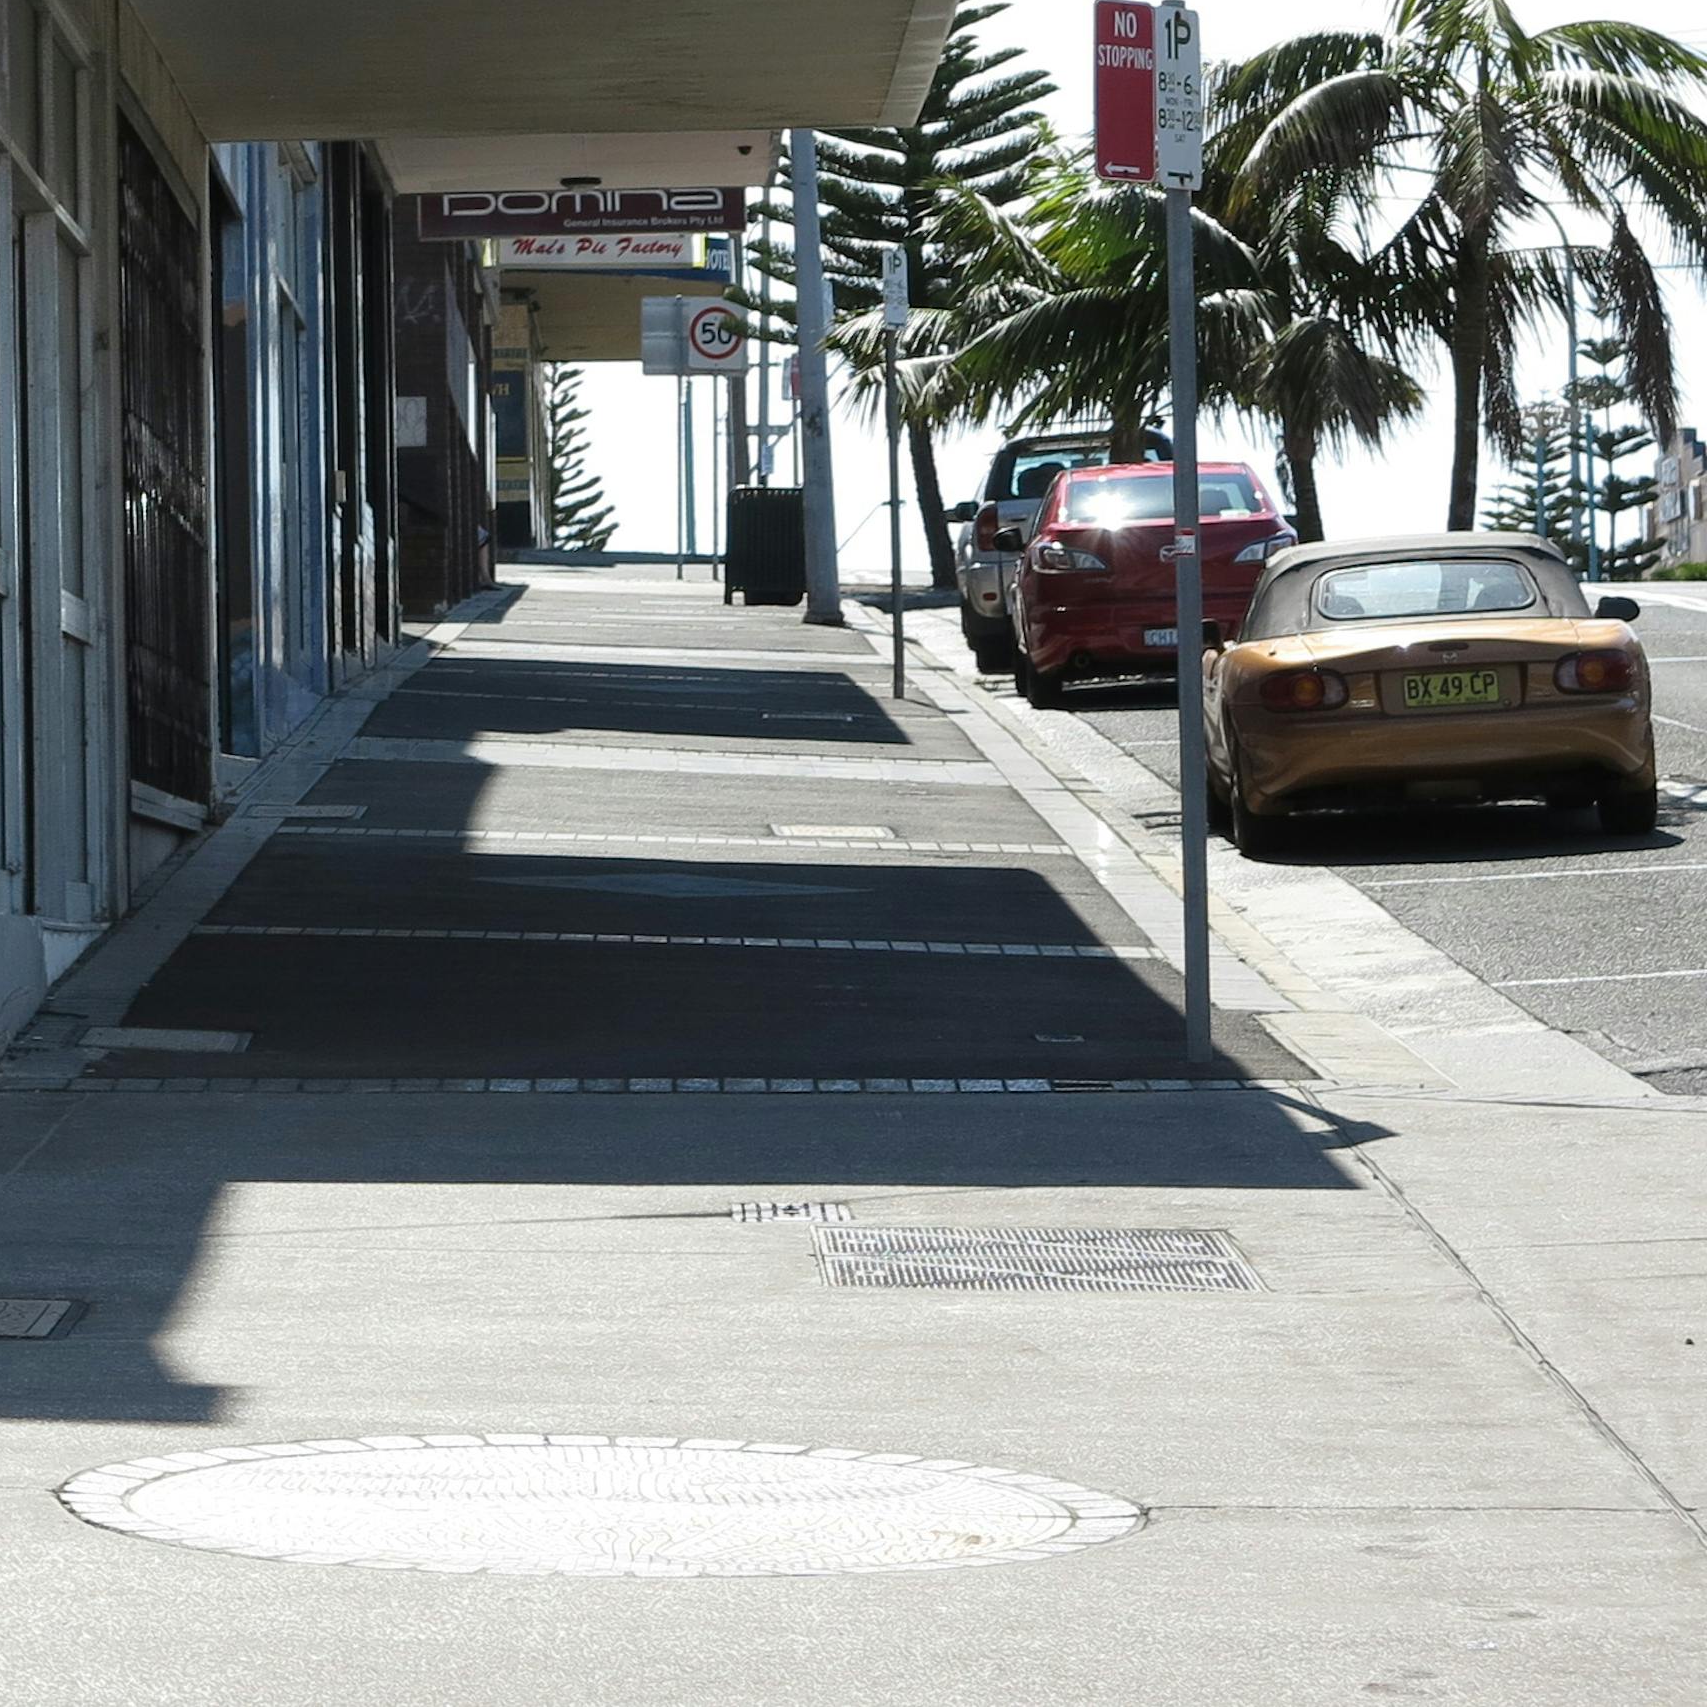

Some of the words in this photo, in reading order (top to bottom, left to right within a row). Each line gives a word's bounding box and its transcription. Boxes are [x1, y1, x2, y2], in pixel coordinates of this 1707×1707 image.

[1114, 10, 1137, 39] NO
[1165, 13, 1191, 60] 1P
[1098, 45, 1153, 71] STOPPING
[563, 217, 601, 229] General
[602, 217, 649, 227] Insurance
[650, 216, 688, 227] Brokers
[689, 216, 706, 227] Pty
[707, 215, 724, 225] Ltd
[575, 236, 607, 256] Pie
[616, 236, 683, 258] Factory
[702, 322, 732, 345] 50
